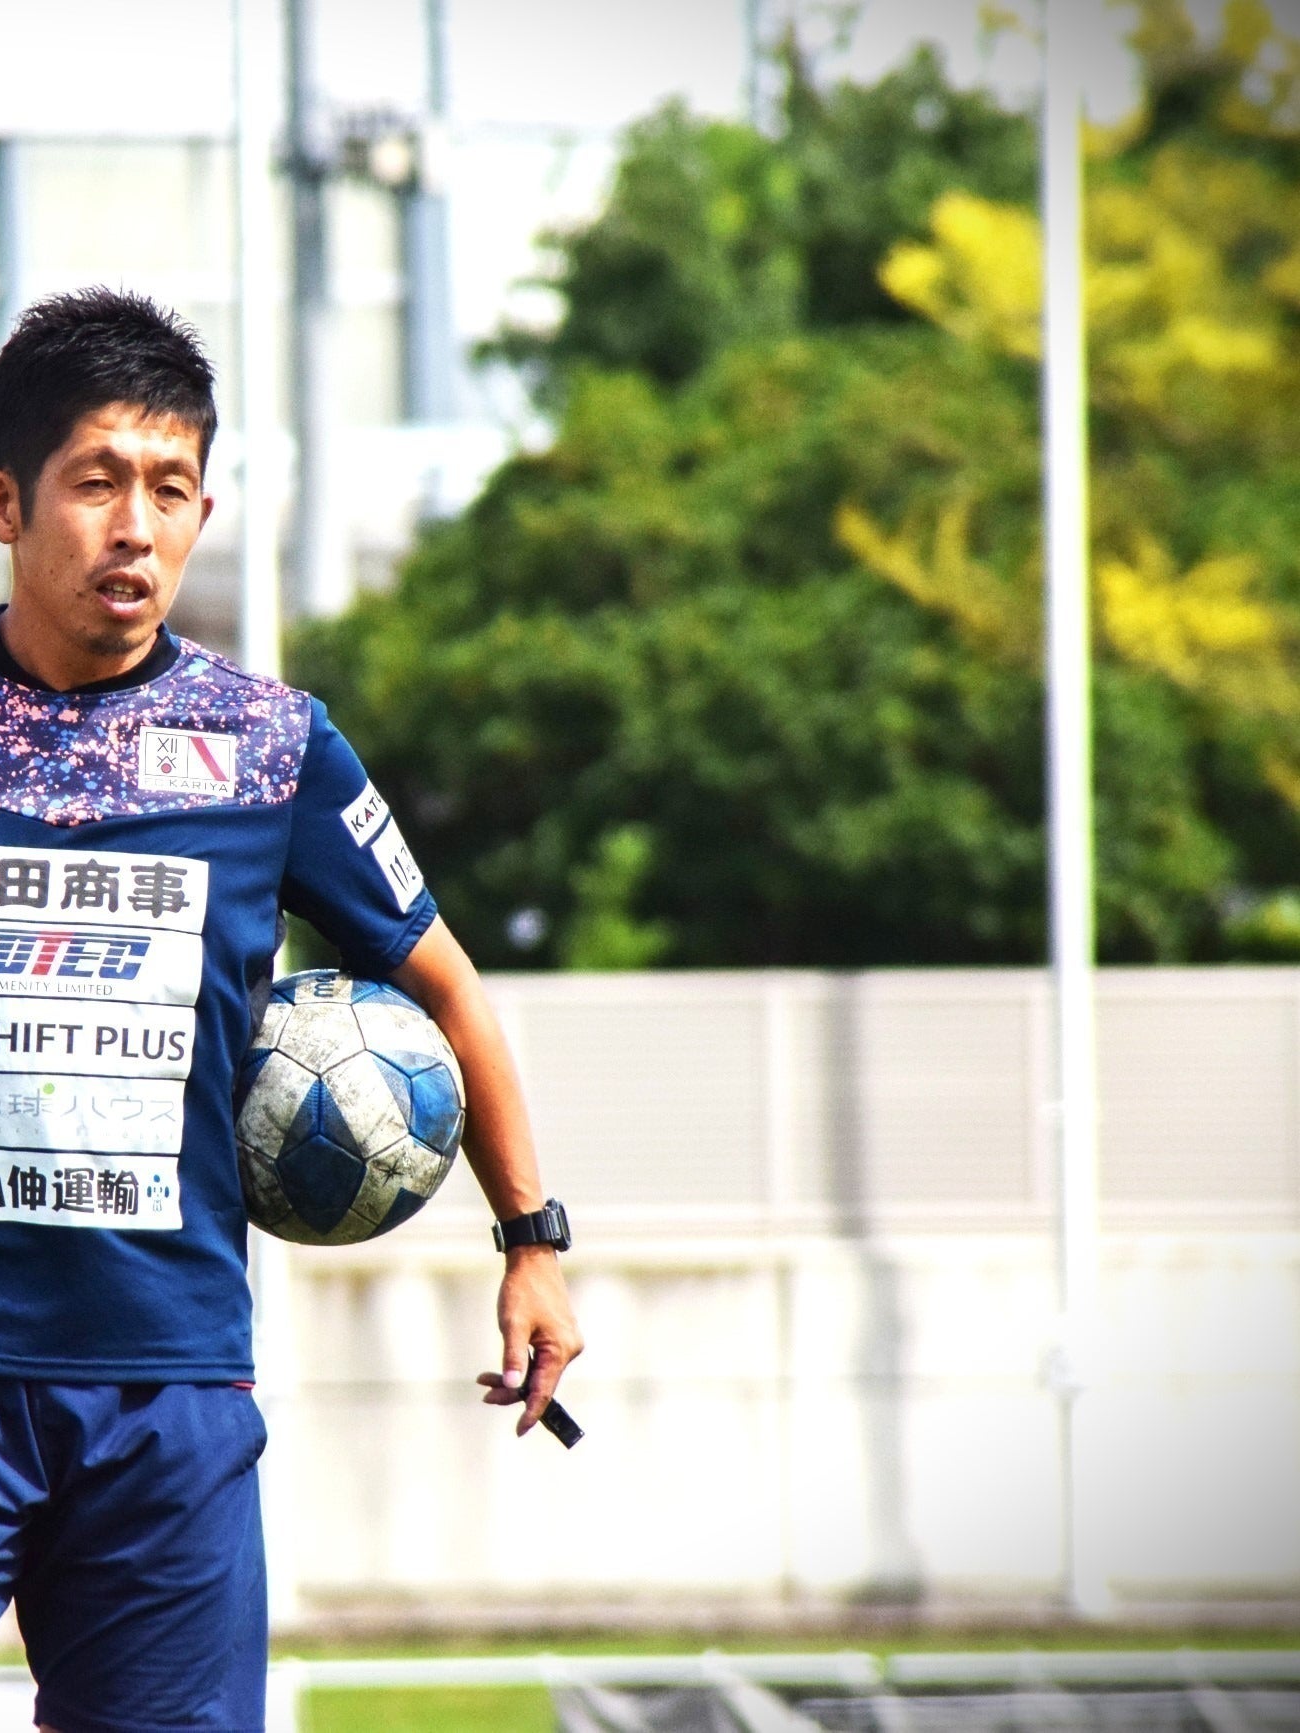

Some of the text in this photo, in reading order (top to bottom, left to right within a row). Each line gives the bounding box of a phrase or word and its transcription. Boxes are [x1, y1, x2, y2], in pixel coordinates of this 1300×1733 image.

[169, 779, 228, 792] KARIYA
[57, 982, 113, 996] LIMITED
[95, 1026, 186, 1061] PLUS
